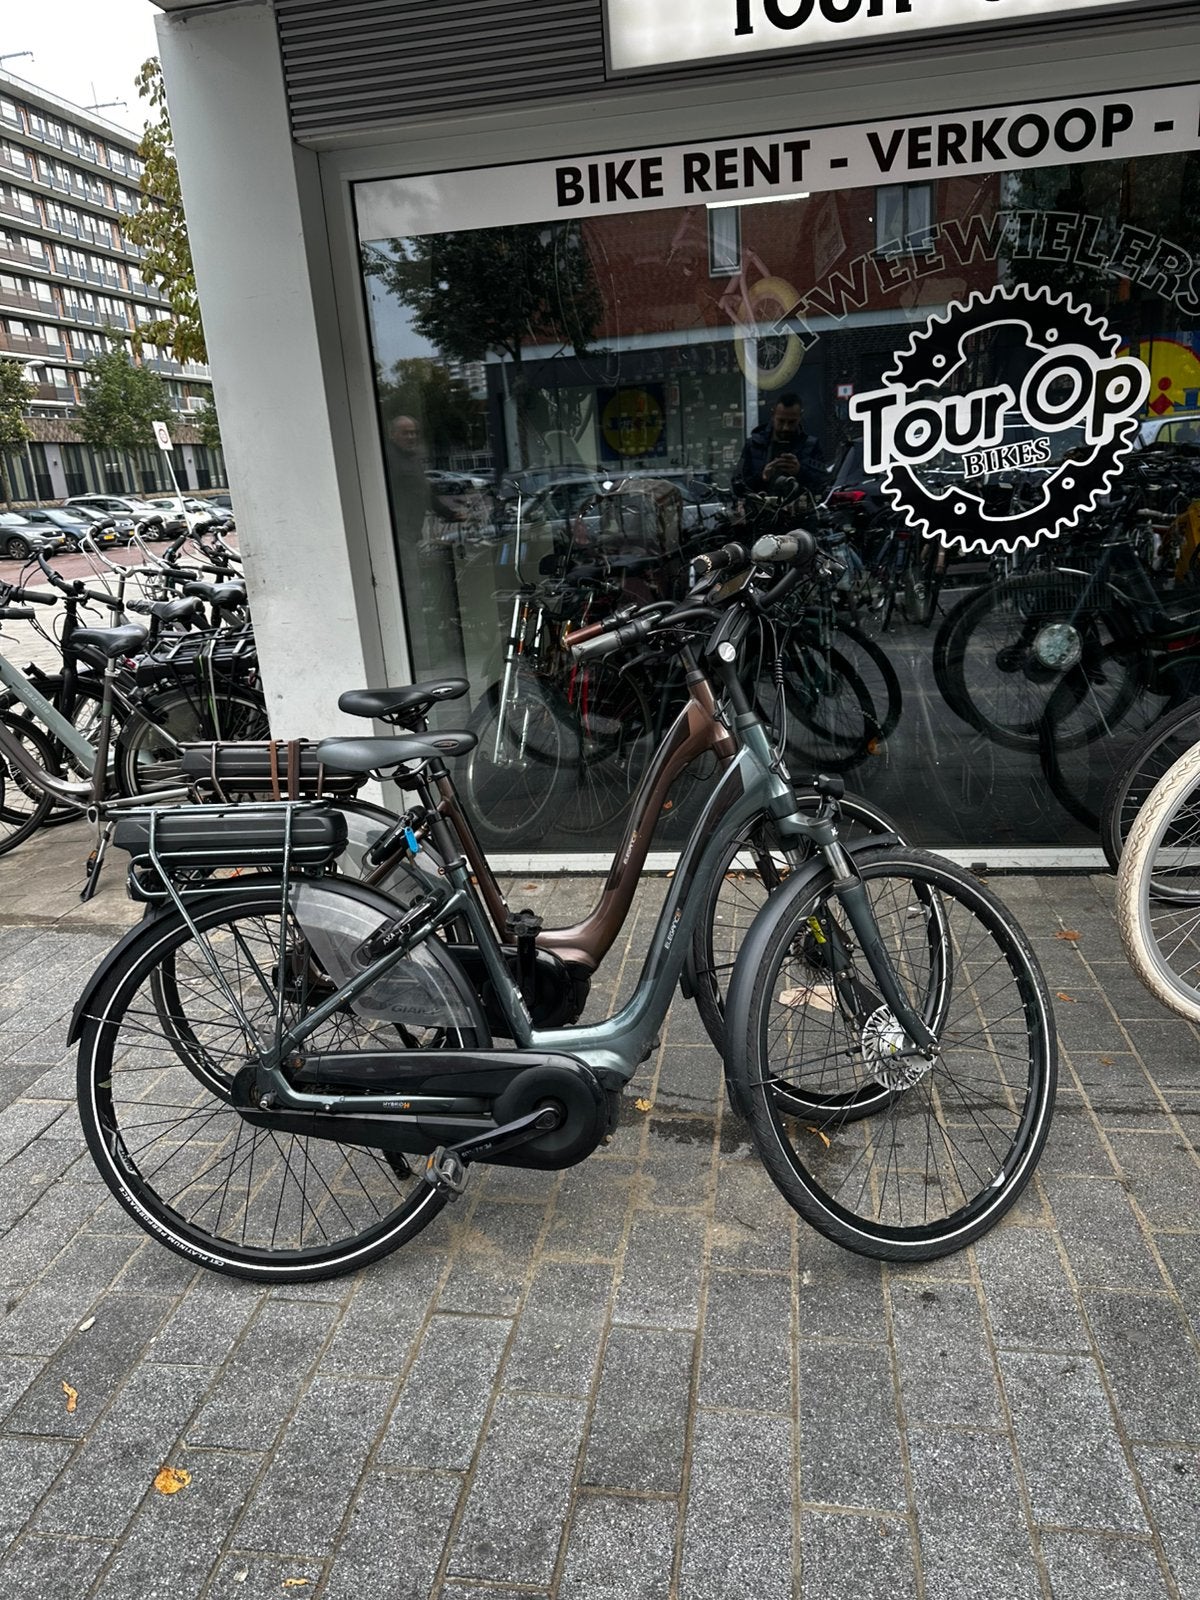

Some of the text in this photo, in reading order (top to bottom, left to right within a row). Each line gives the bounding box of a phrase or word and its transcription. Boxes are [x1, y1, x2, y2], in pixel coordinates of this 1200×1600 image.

[556, 157, 663, 207] BIKE
[683, 140, 811, 194] RENT
[866, 103, 1134, 173] VERKOOP
[772, 209, 1200, 351] TWEEWIELERS
[850, 384, 1015, 473] Tour
[1021, 344, 1150, 445] Op
[963, 437, 1051, 479] BIKES
[383, 932, 396, 945] AXA
[119, 1187, 168, 1237] PERFORMANCE
[167, 1235, 208, 1261] PLATINUM
